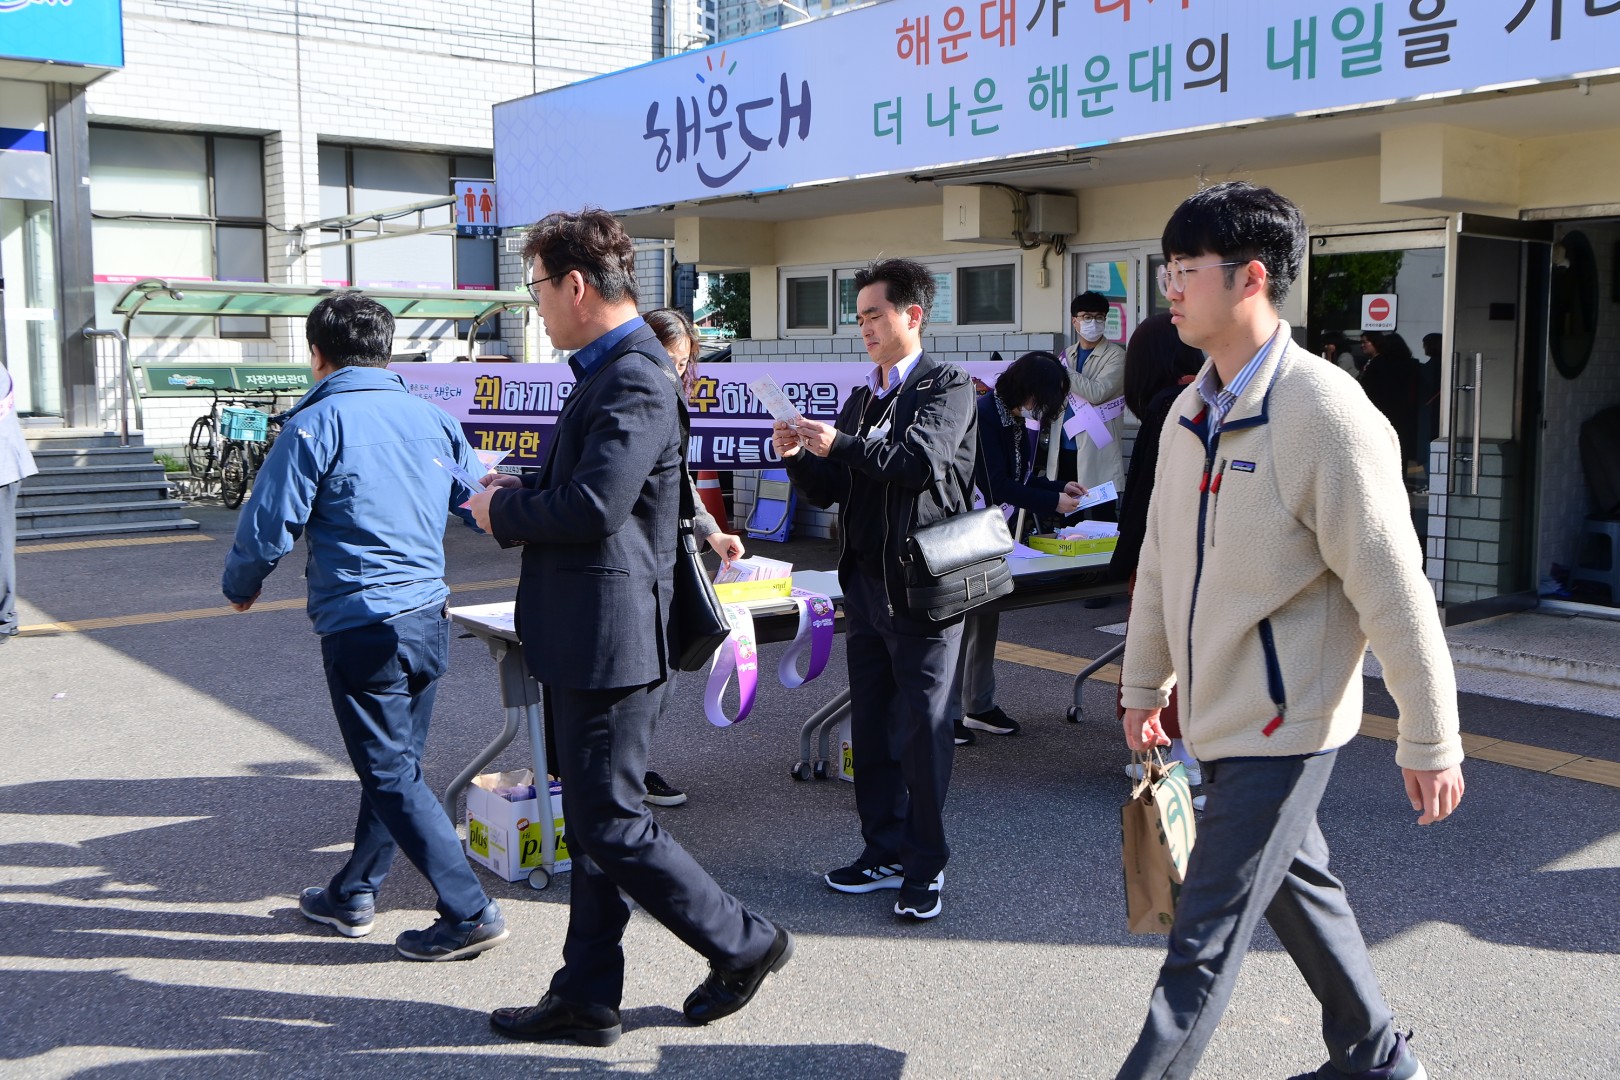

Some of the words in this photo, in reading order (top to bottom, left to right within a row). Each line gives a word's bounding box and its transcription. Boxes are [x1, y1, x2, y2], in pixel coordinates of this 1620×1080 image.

[896, 0, 1066, 66] 해운대가
[874, 97, 902, 145] 더
[927, 77, 1003, 137] 나은
[1028, 32, 1229, 119] 해운대의
[1266, 0, 1457, 80] 내일을
[643, 72, 812, 173] 해운대
[465, 226, 495, 235] 화장실
[245, 374, 309, 386] 자전거보관대
[1058, 544, 1072, 554] plus
[469, 826, 488, 849] plus
